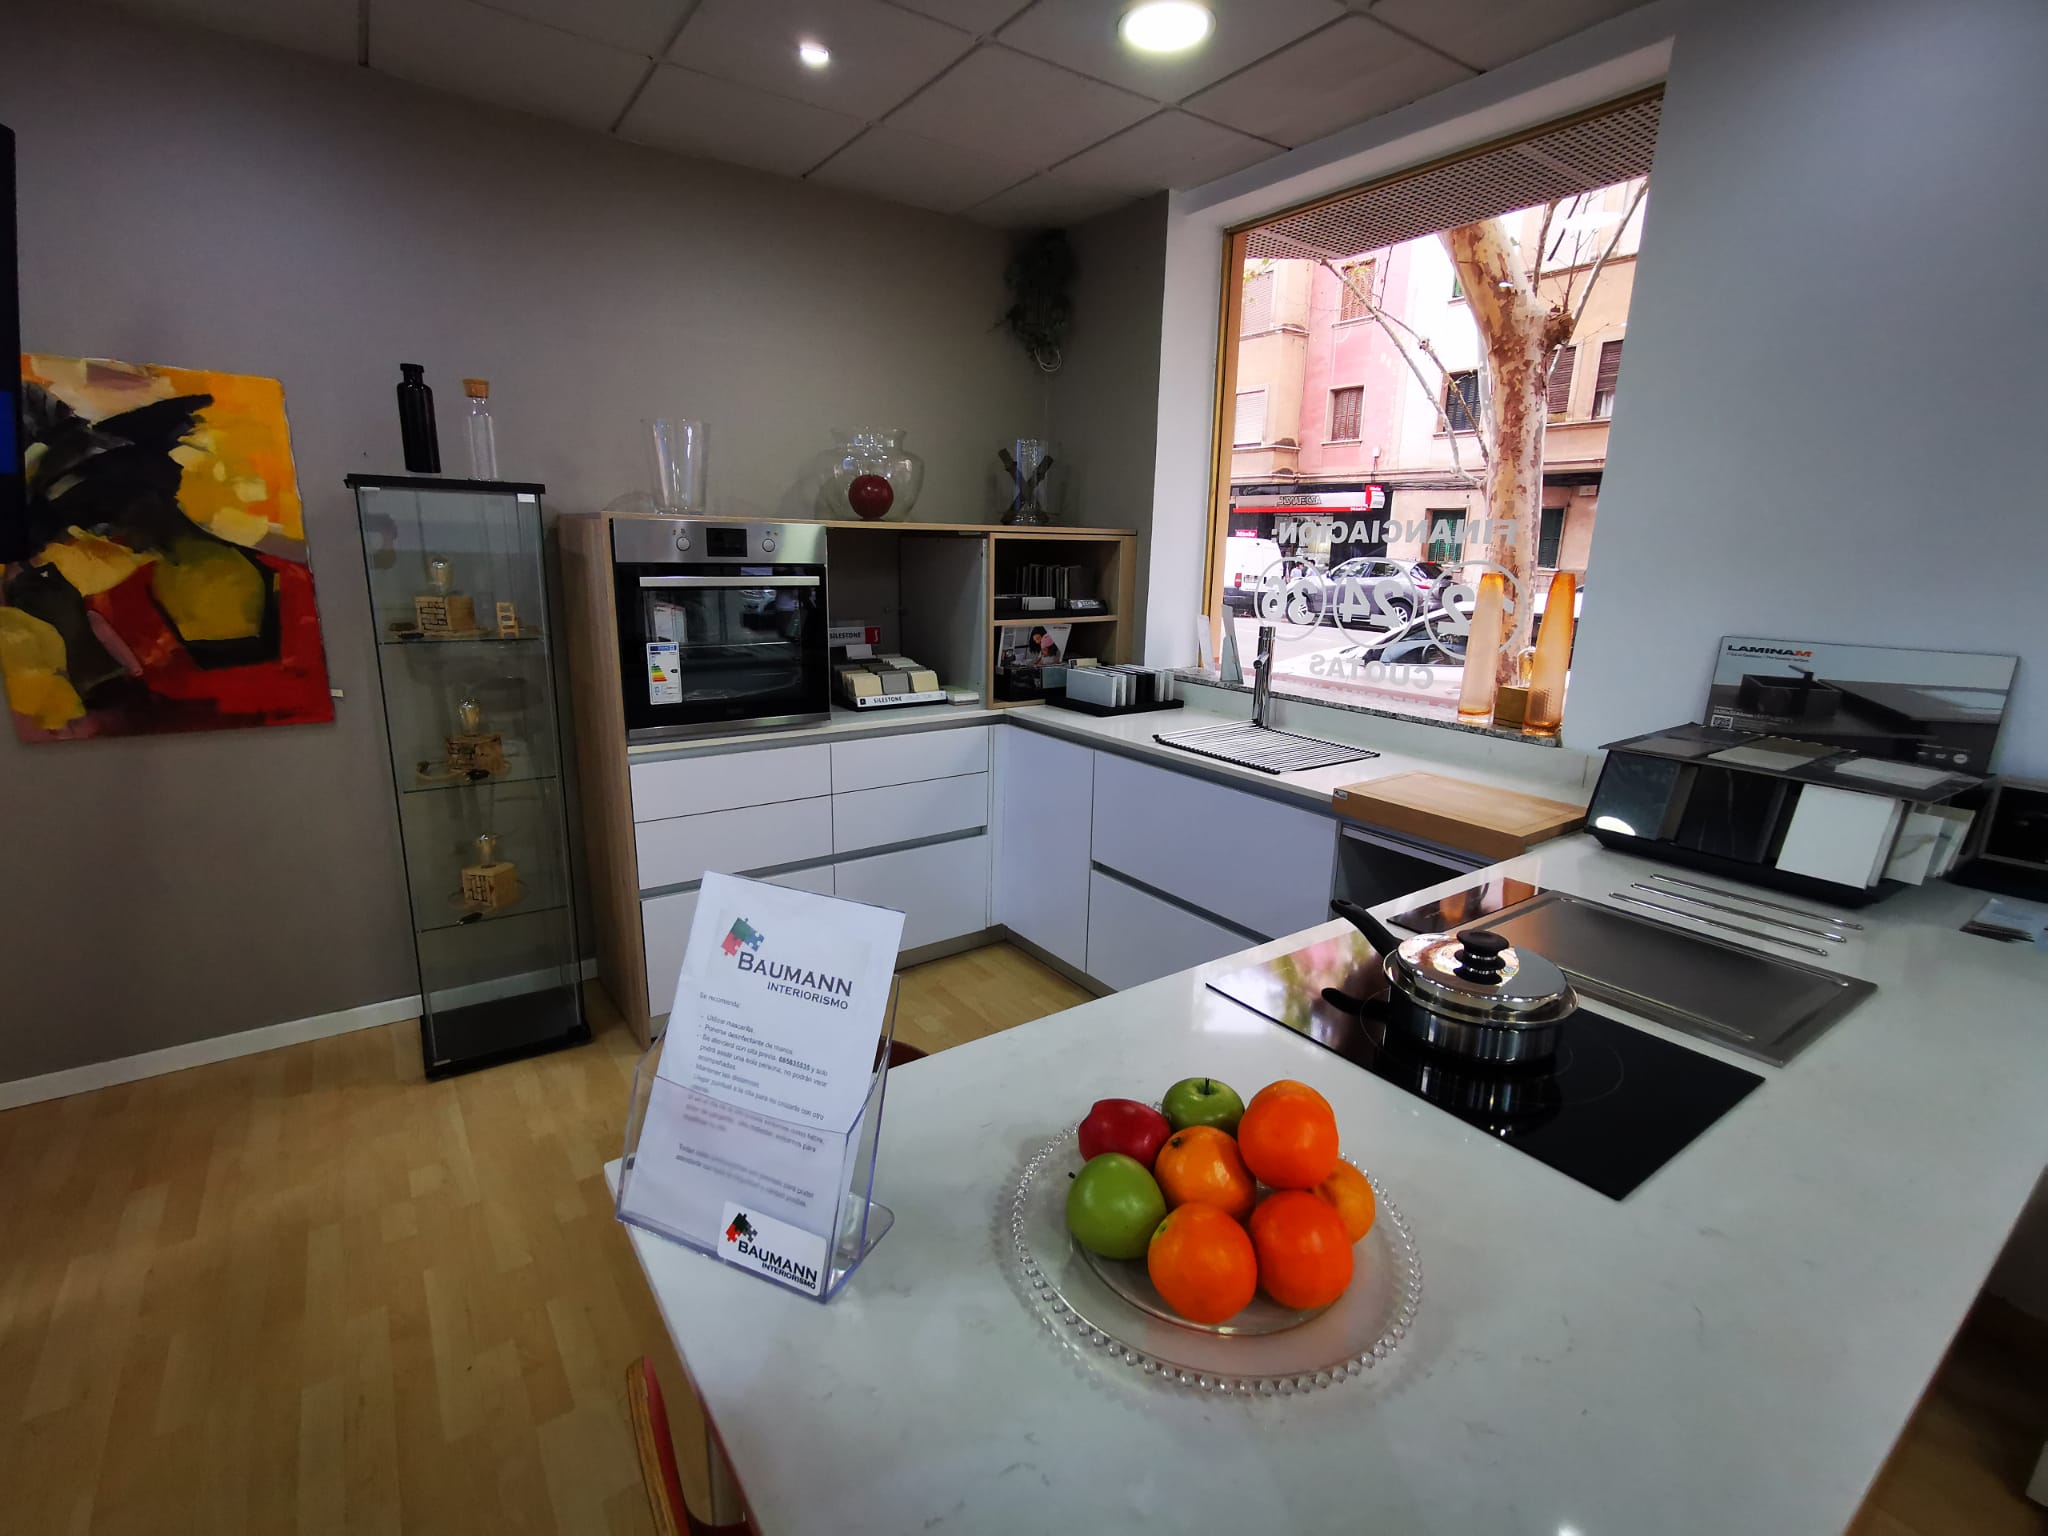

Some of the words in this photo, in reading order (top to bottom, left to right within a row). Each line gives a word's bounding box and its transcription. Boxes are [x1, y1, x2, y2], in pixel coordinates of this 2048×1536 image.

[1727, 644, 1813, 657] LAMINAM
[737, 951, 853, 997] BAUMANN
[767, 981, 849, 1010] INTERIORISMO
[738, 1240, 818, 1283] BAUMANN
[761, 1262, 816, 1290] INTERIORISMO
